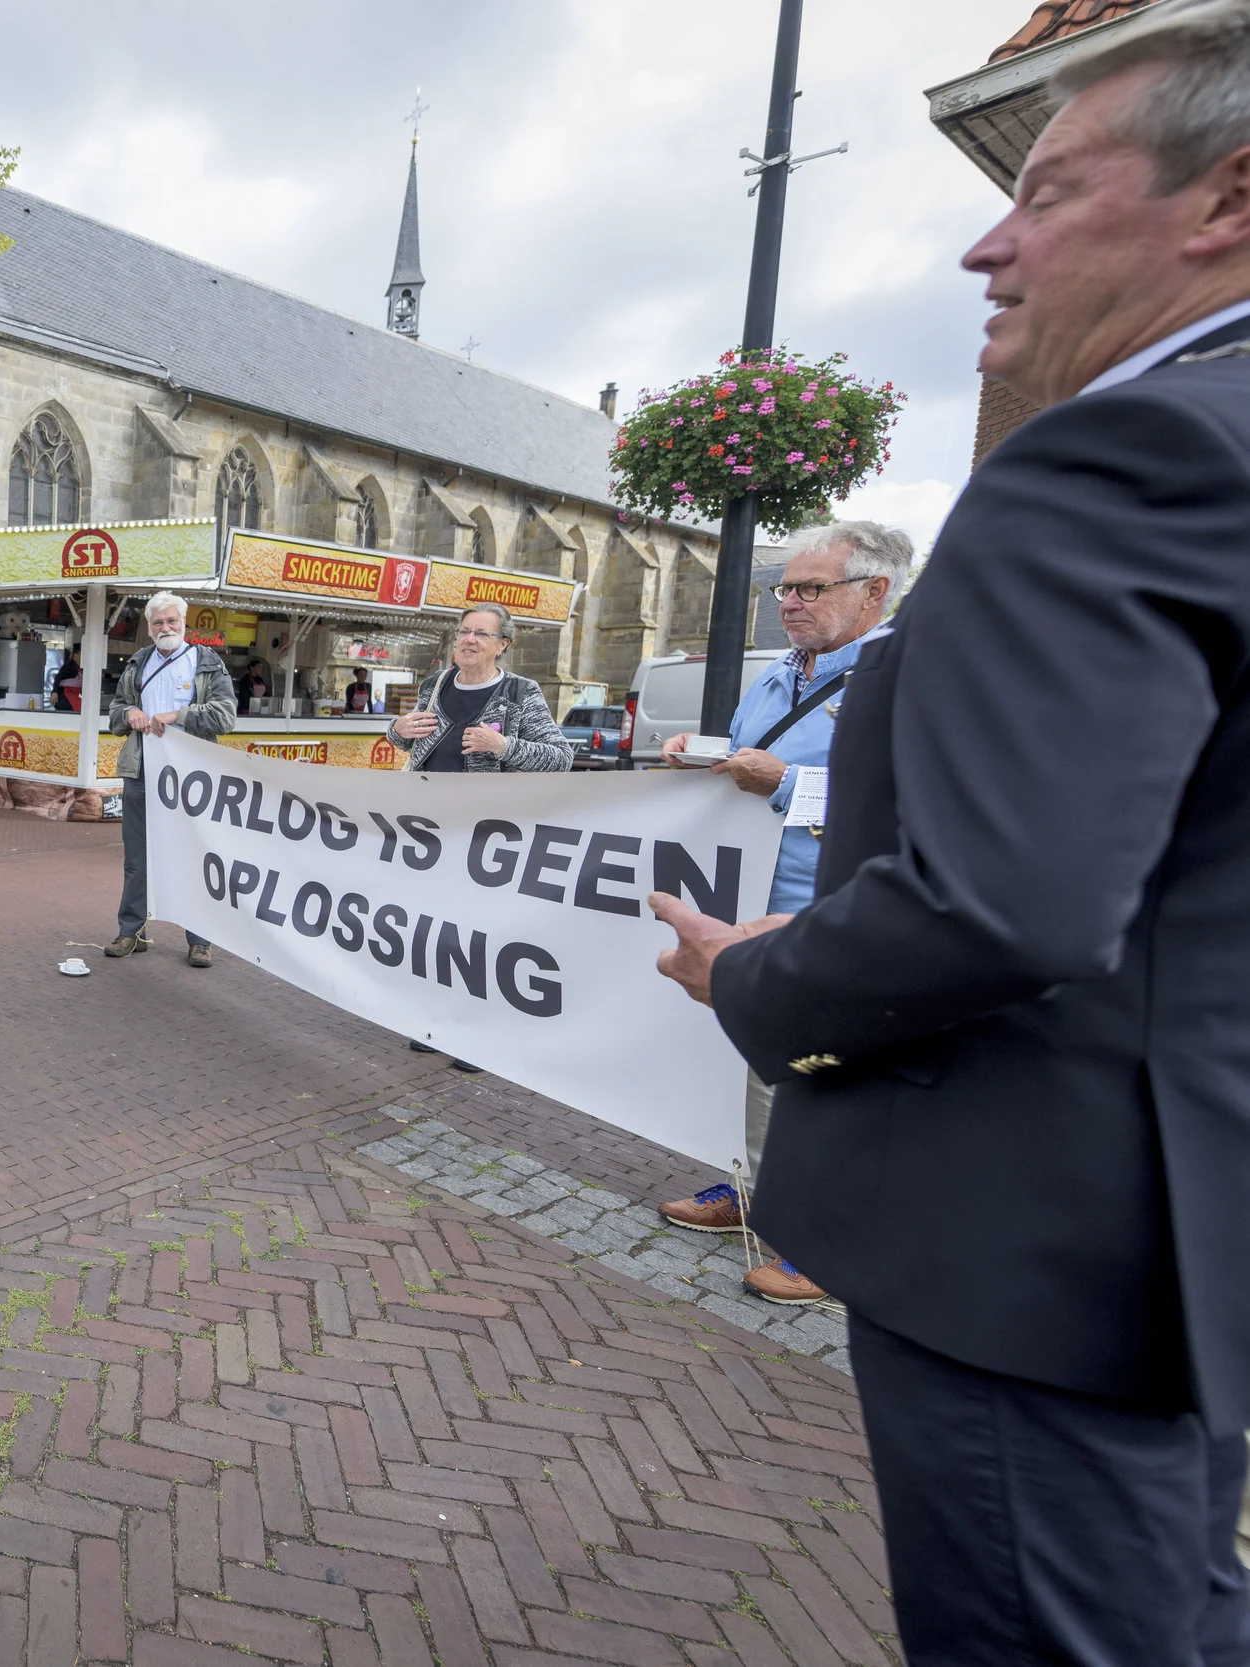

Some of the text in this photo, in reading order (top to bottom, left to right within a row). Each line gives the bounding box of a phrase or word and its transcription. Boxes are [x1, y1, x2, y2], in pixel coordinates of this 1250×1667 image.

[73, 543, 106, 566] ST
[64, 566, 118, 577] SNACKTIME
[287, 557, 379, 589] SNACKTIME
[470, 580, 538, 607] SNACKTIME
[199, 615, 213, 629] ST
[2, 741, 19, 760] ST
[375, 747, 391, 762] ST
[157, 765, 743, 925] OORLOG IS GEEN
[203, 852, 563, 1018] OPLOSSING
